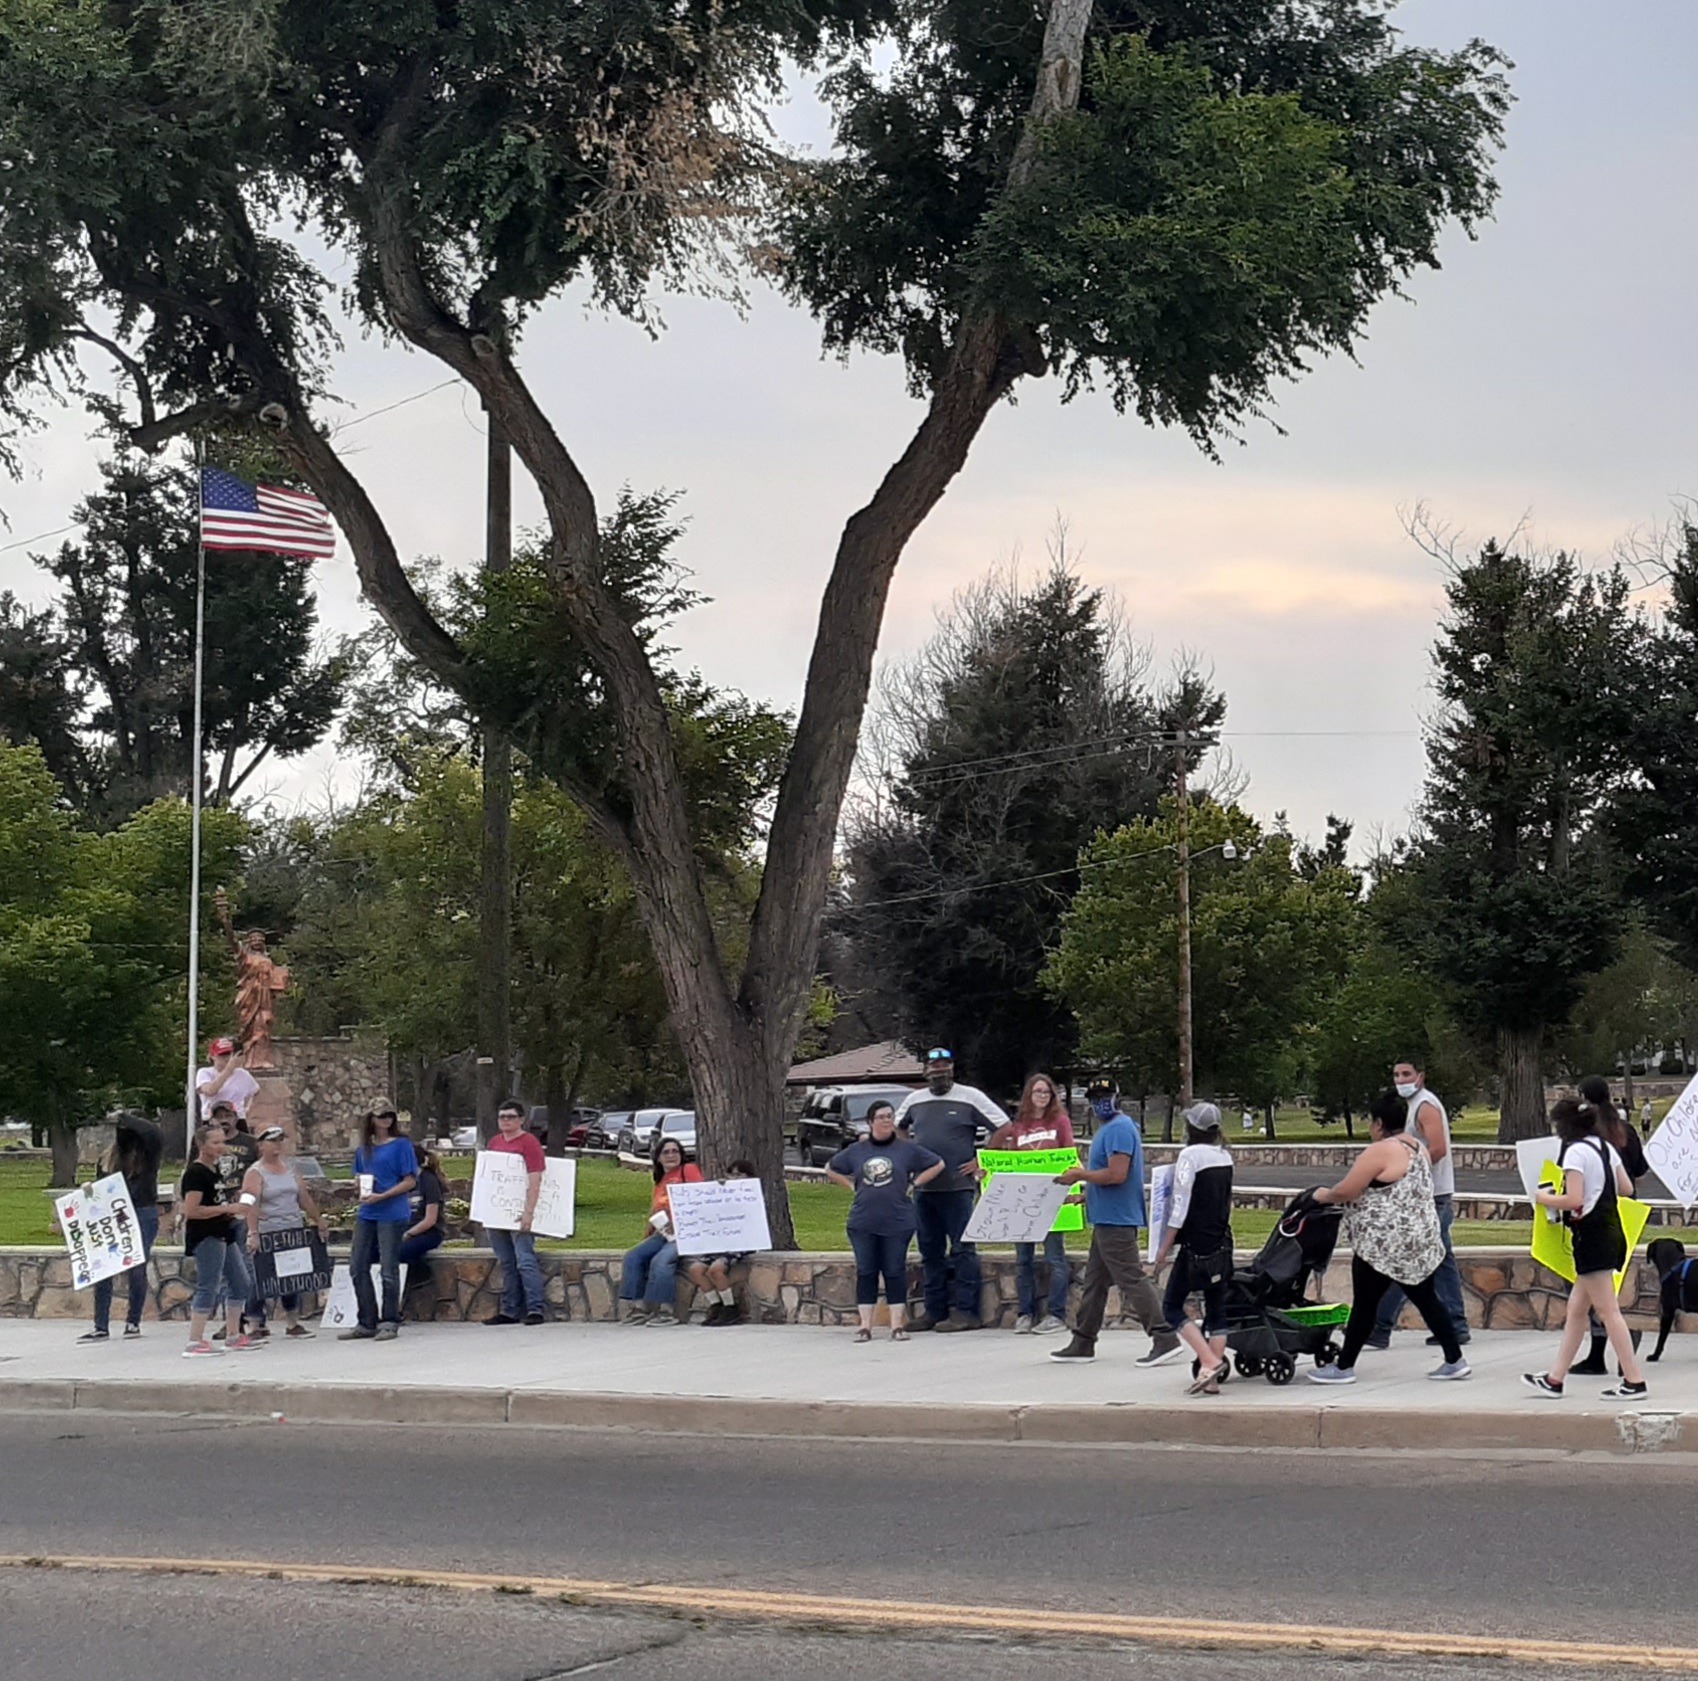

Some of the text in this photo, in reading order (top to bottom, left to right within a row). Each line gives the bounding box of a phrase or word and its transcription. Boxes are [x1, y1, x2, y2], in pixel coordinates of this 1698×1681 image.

[1647, 1134, 1674, 1167] Our
[1671, 1147, 1690, 1170] are
[110, 1197, 134, 1255] Children
[262, 1229, 314, 1251] DEFUND
[262, 1272, 329, 1295] HOLLYWOOD
